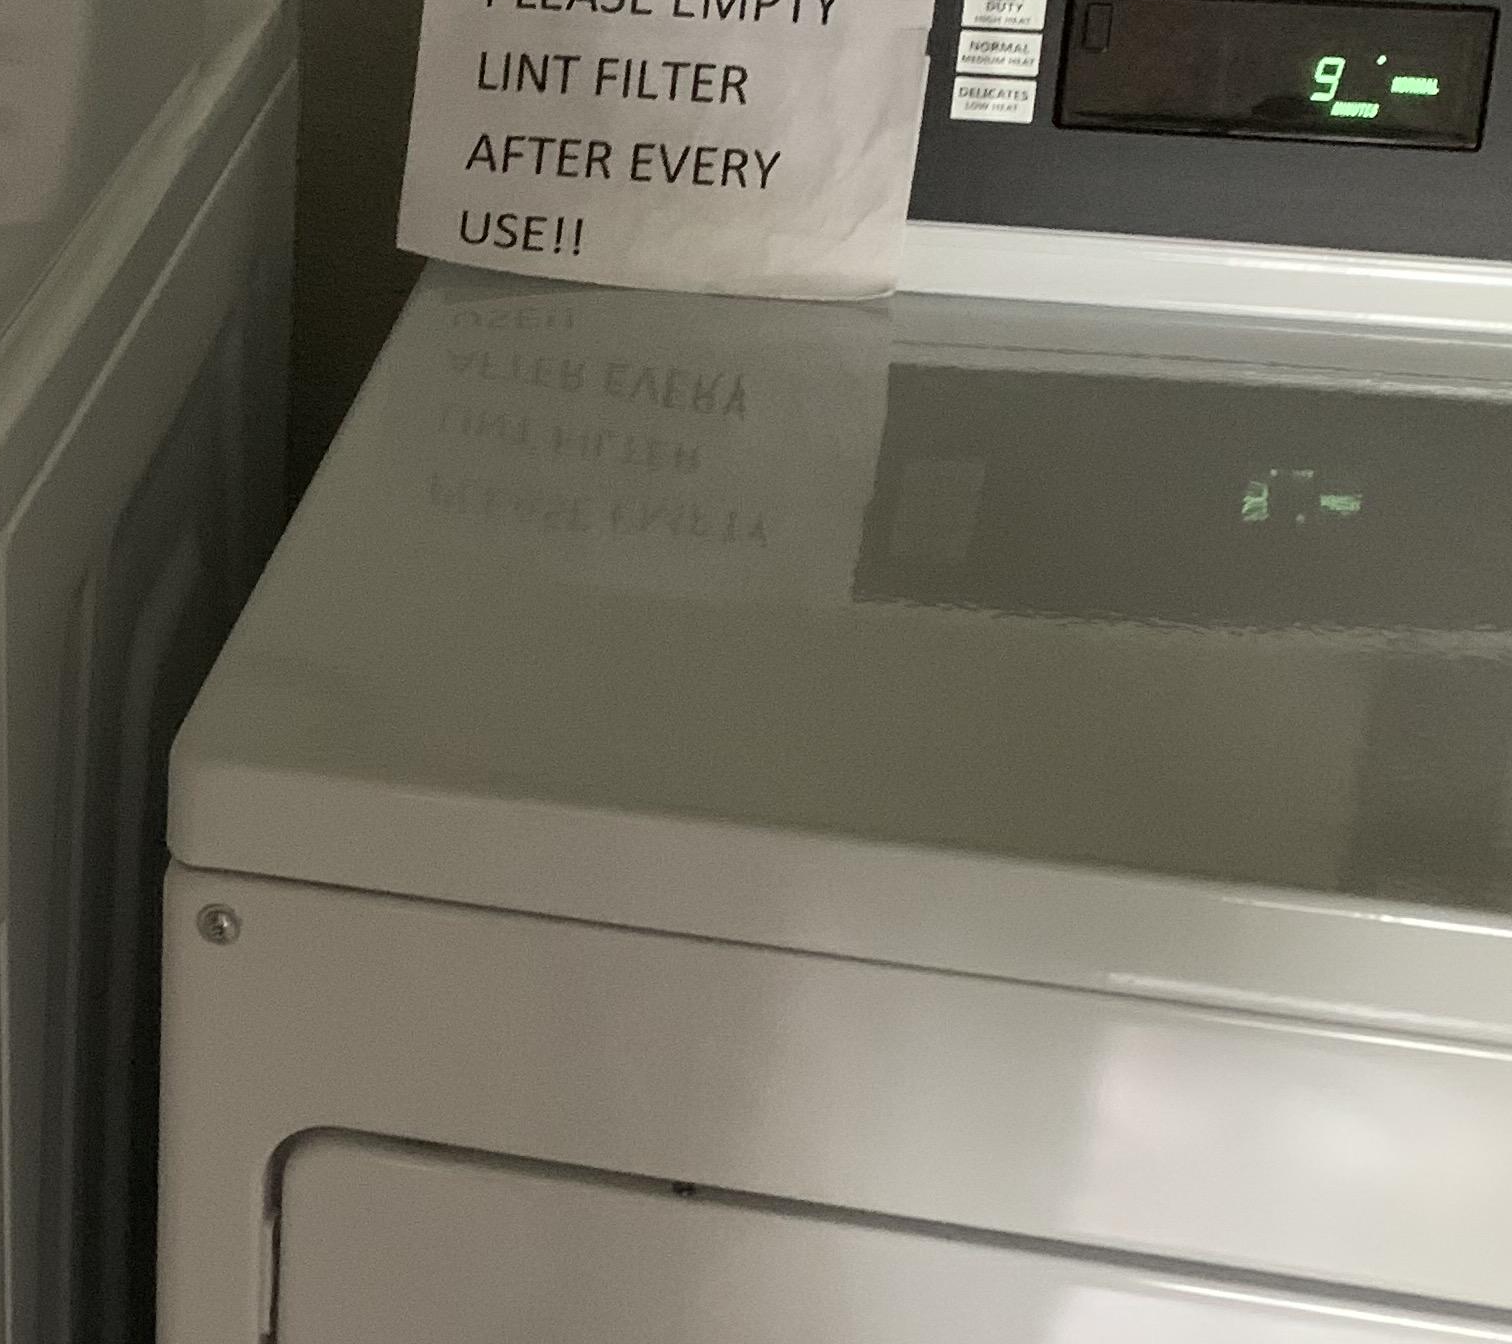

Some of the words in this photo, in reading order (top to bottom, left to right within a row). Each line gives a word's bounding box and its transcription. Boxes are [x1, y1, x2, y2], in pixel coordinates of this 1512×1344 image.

[985, 1, 1023, 13] DUTY
[969, 40, 1030, 55] NORMAL
[961, 54, 1006, 65] MEDIUM
[477, 51, 581, 96] LINT
[594, 59, 750, 106] FILTER
[1310, 56, 1345, 102] 9
[958, 86, 1029, 102] DELICATES
[964, 101, 989, 112] LOW
[991, 102, 1019, 113] HEAT
[465, 133, 612, 180] AFTER
[630, 142, 781, 191] EVERY
[459, 211, 585, 256] USE!!
